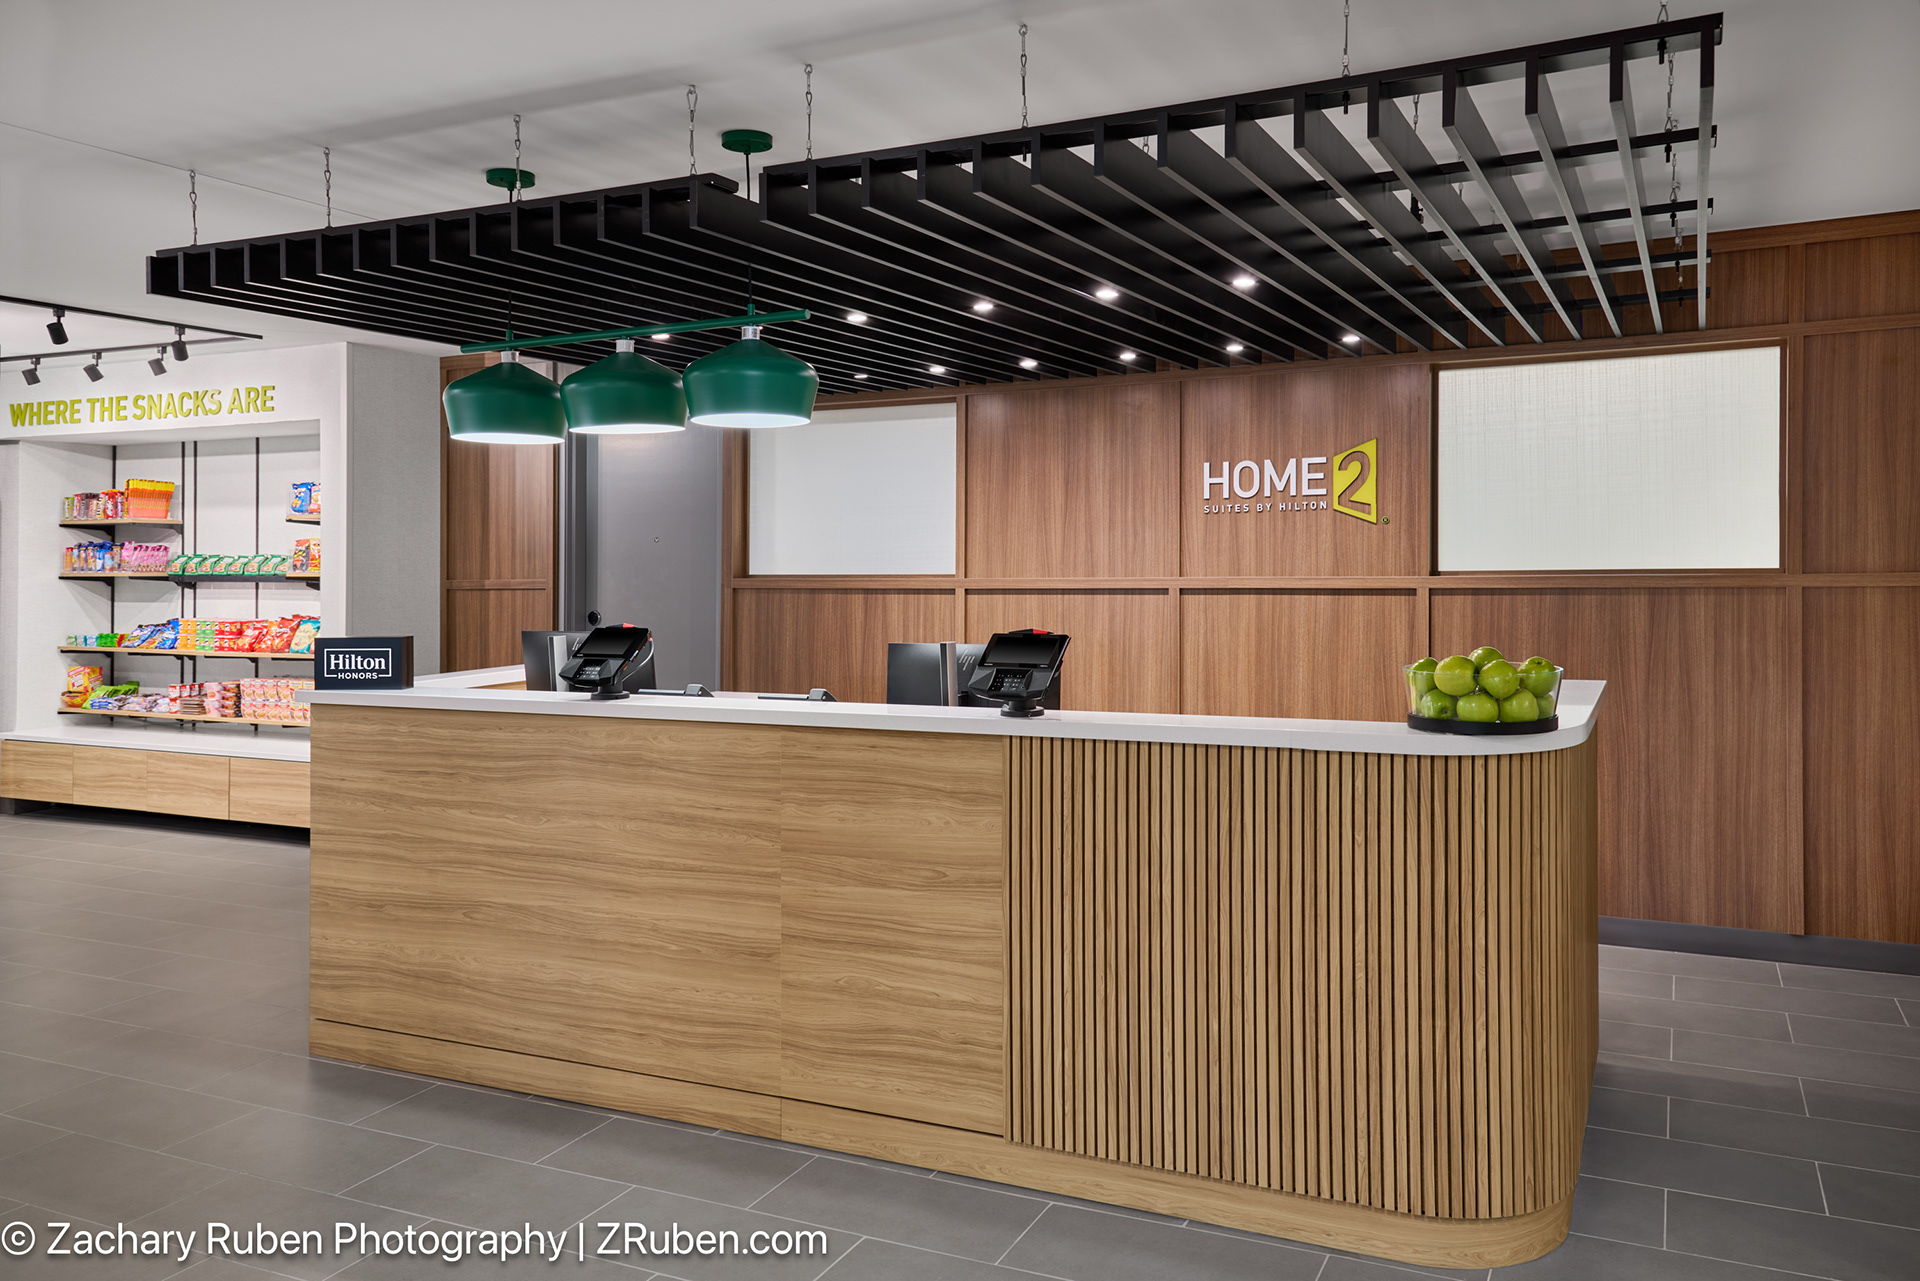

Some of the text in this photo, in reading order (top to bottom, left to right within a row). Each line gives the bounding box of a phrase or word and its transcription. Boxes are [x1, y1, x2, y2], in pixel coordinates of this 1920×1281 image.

[10, 386, 276, 428] WHERE THE SNACKS ARE
[1204, 501, 1327, 514] SUITES BY HILTON
[329, 654, 386, 670] Hilton
